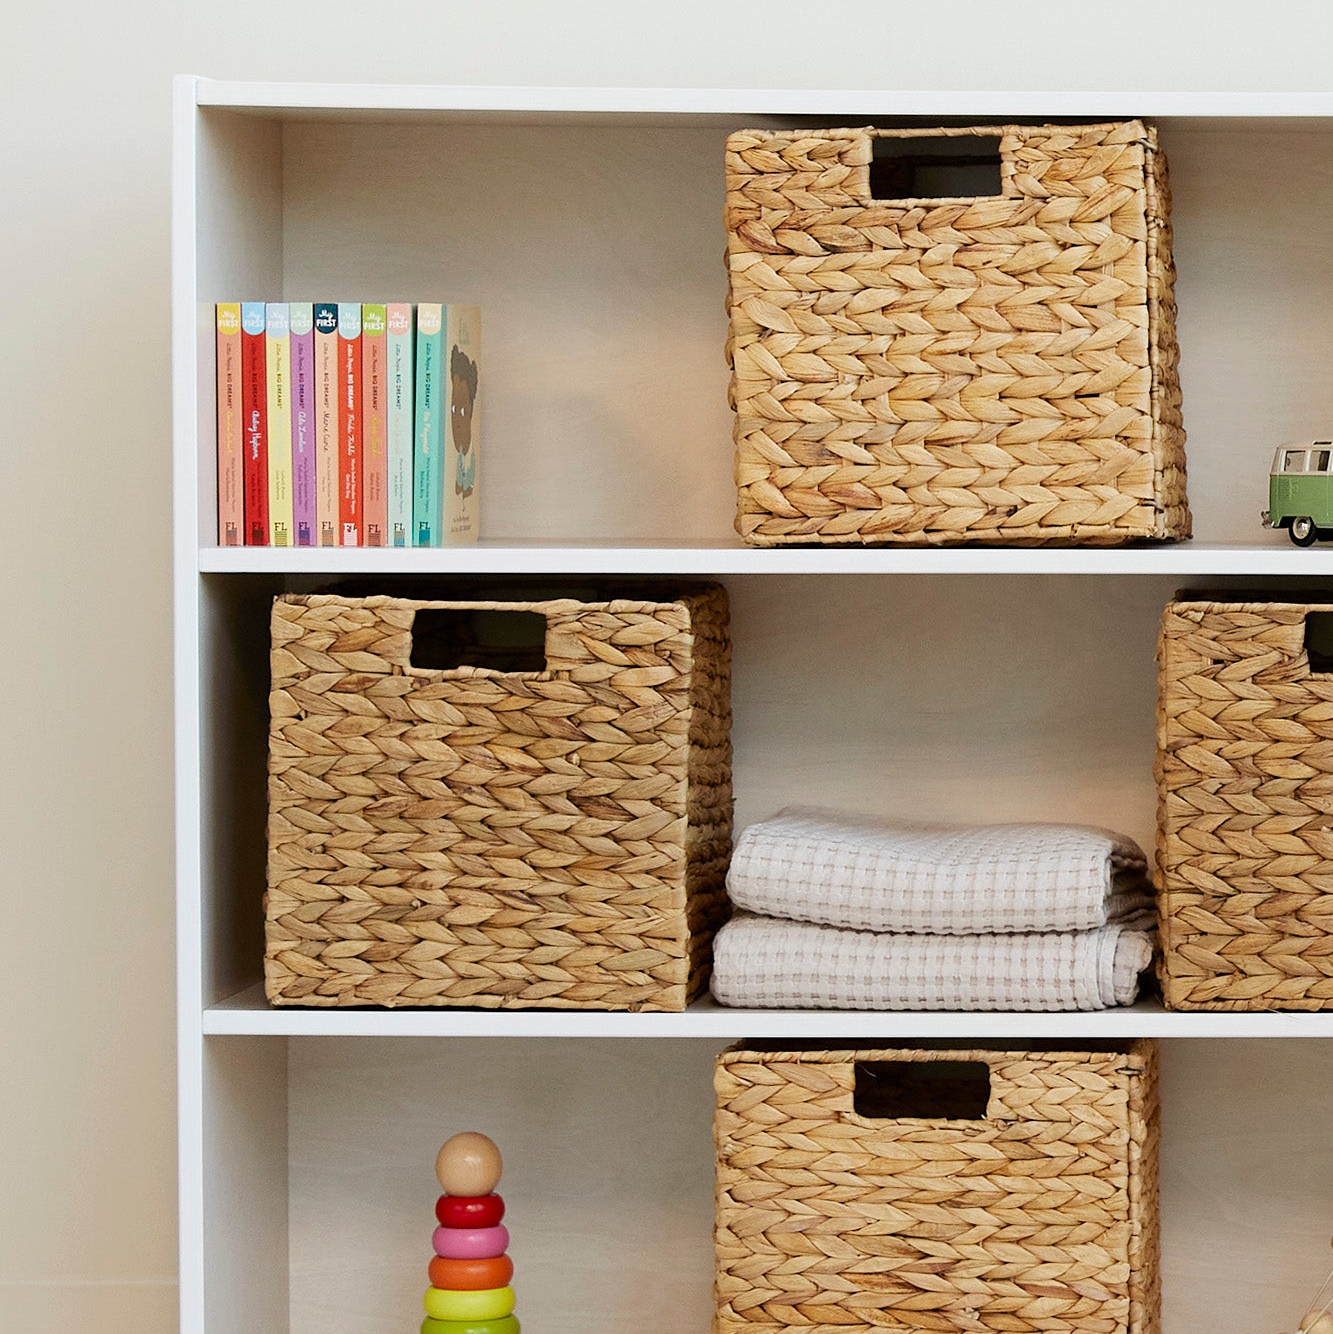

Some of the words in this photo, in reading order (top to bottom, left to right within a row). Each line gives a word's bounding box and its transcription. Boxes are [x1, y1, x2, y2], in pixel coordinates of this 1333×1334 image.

[319, 309, 333, 321] My
[367, 312, 382, 323] My
[219, 319, 238, 327] FIRST
[244, 319, 261, 327] FIRST
[291, 319, 310, 327] FIRST
[316, 319, 336, 327] FIRST
[340, 321, 360, 329] FIRST
[365, 322, 384, 330] FIRST
